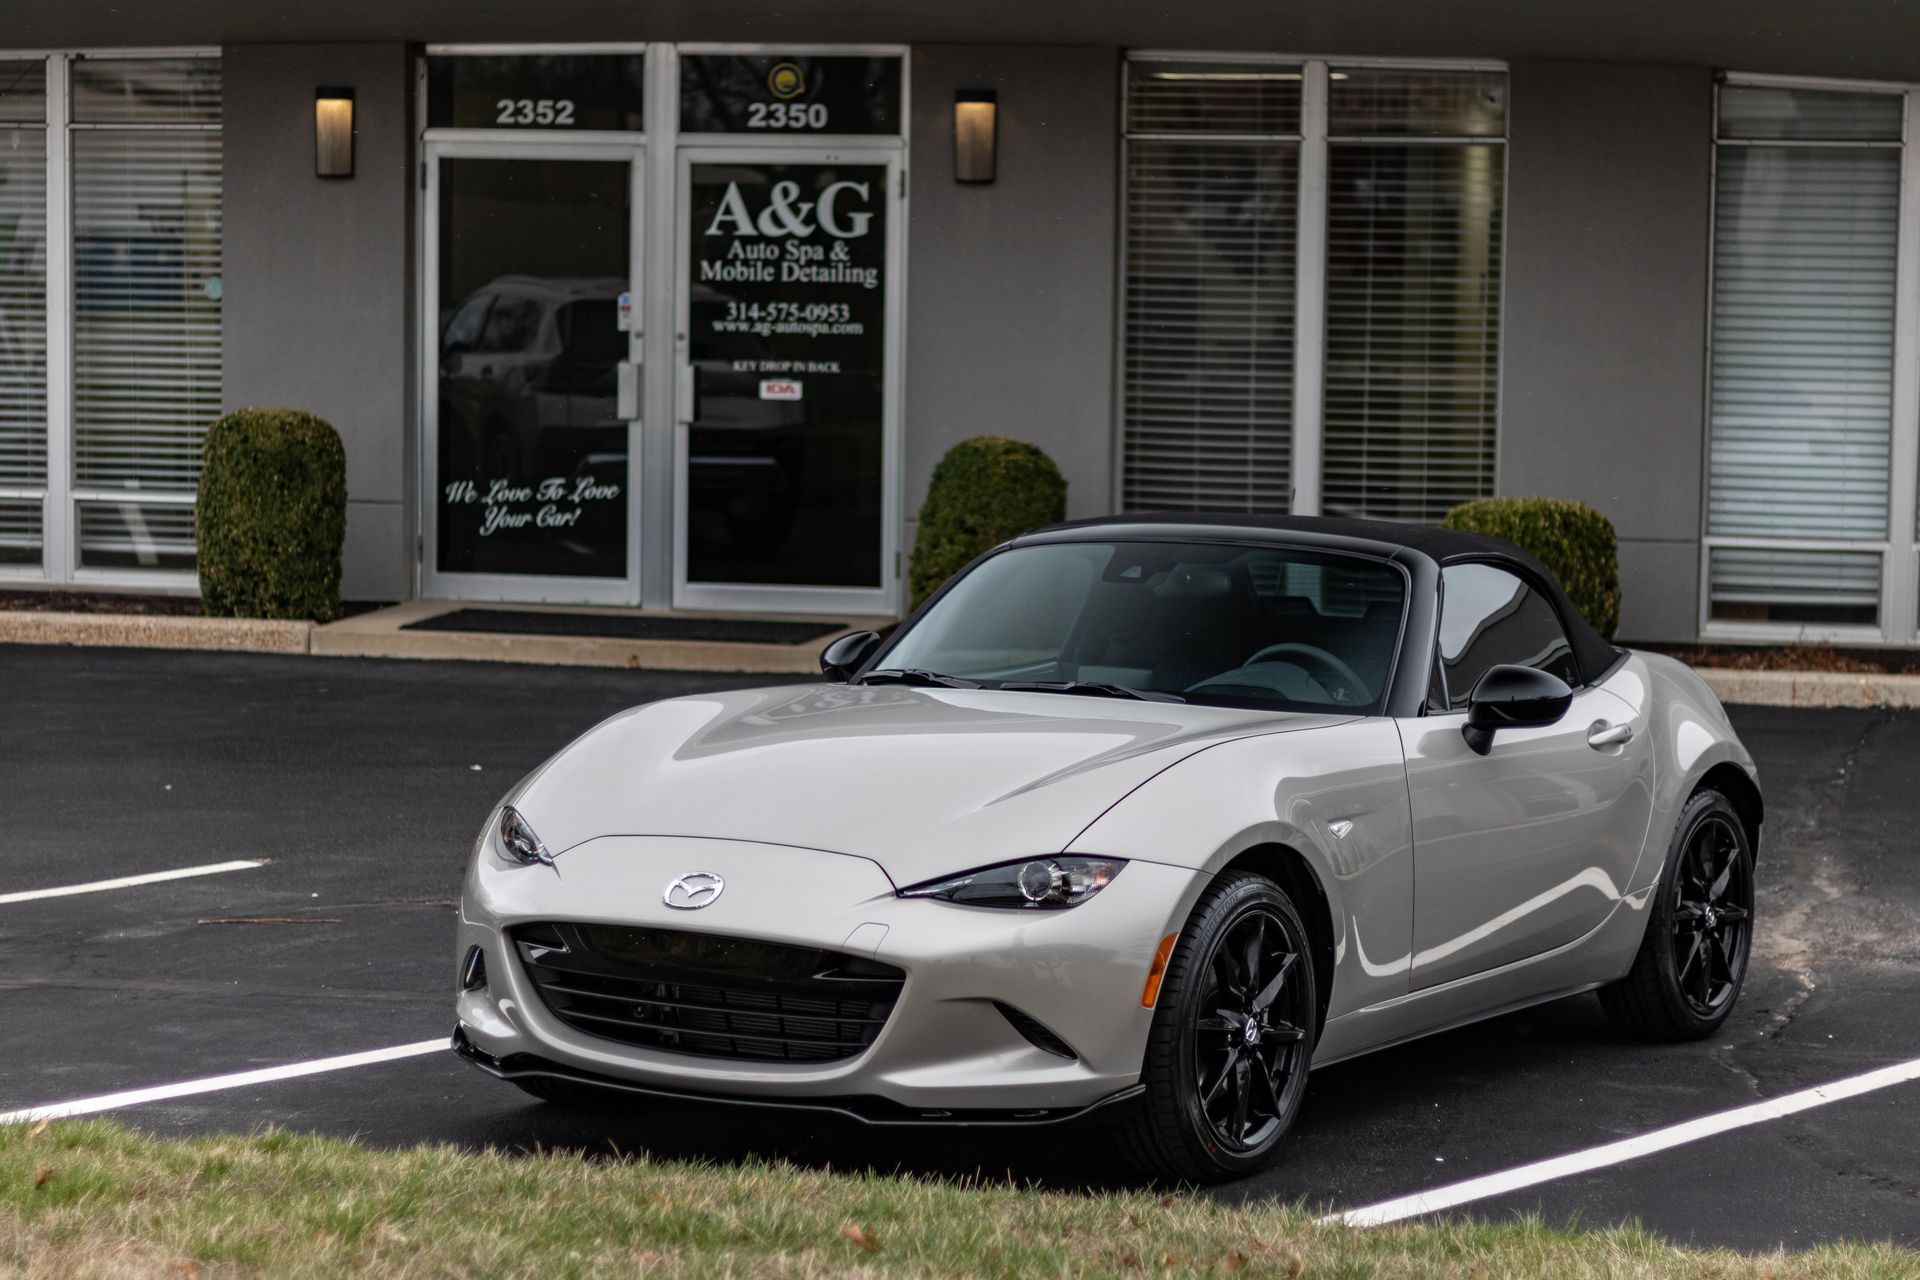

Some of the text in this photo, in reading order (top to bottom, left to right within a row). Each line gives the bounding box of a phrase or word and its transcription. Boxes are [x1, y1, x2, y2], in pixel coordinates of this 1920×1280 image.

[496, 99, 576, 125] 2352
[747, 103, 828, 128] 2350
[704, 180, 875, 238] A&G
[727, 239, 849, 265] Auto Spa &
[700, 260, 878, 289] Mobile Detailing
[726, 302, 851, 322] 314-575-0953
[733, 360, 758, 372] KEY
[760, 361, 793, 373] DROP
[807, 361, 841, 373] BACK
[446, 475, 621, 506] We Love To Love
[479, 503, 583, 537] Your Car!
